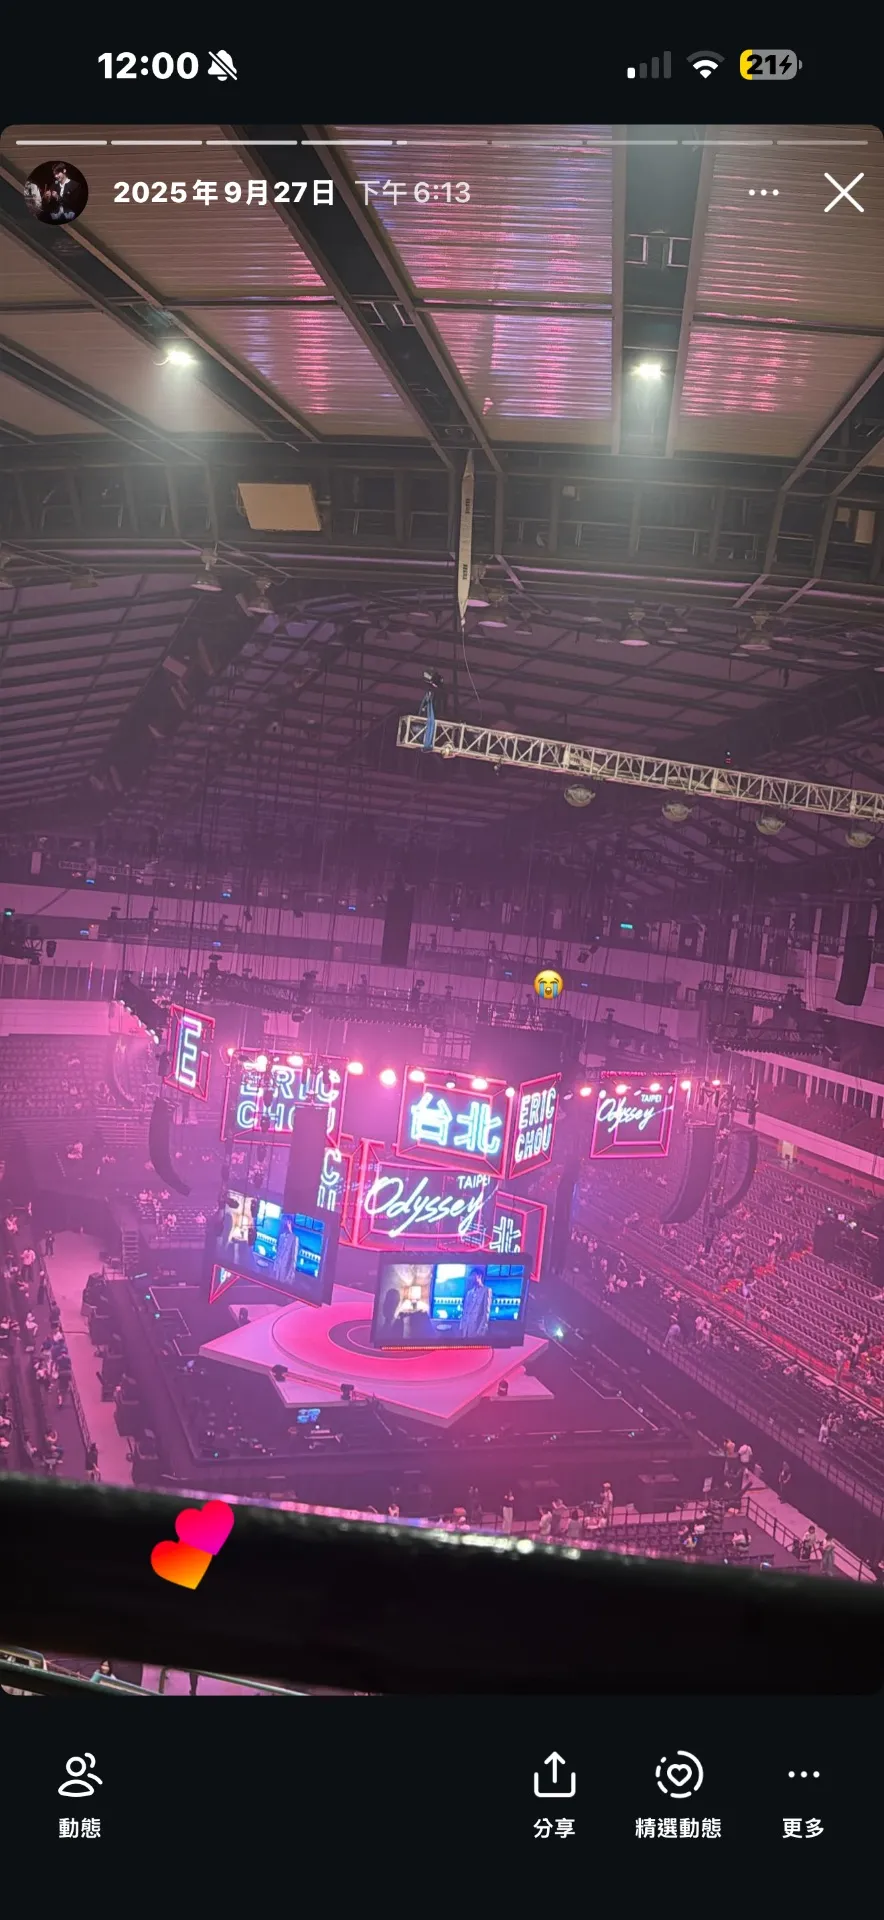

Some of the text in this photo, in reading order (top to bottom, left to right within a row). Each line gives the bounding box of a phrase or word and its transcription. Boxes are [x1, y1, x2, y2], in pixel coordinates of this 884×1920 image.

[175, 1015, 202, 1089] E
[236, 1100, 336, 1135] CH
[518, 1087, 556, 1130] ERIC
[597, 1096, 656, 1133] Odyssey
[641, 1094, 662, 1103] TAIPEI
[411, 1091, 503, 1154] 台北
[514, 1123, 552, 1164] CHOU
[457, 1174, 491, 1191] TAIPEI
[363, 1176, 485, 1238] Odyssey
